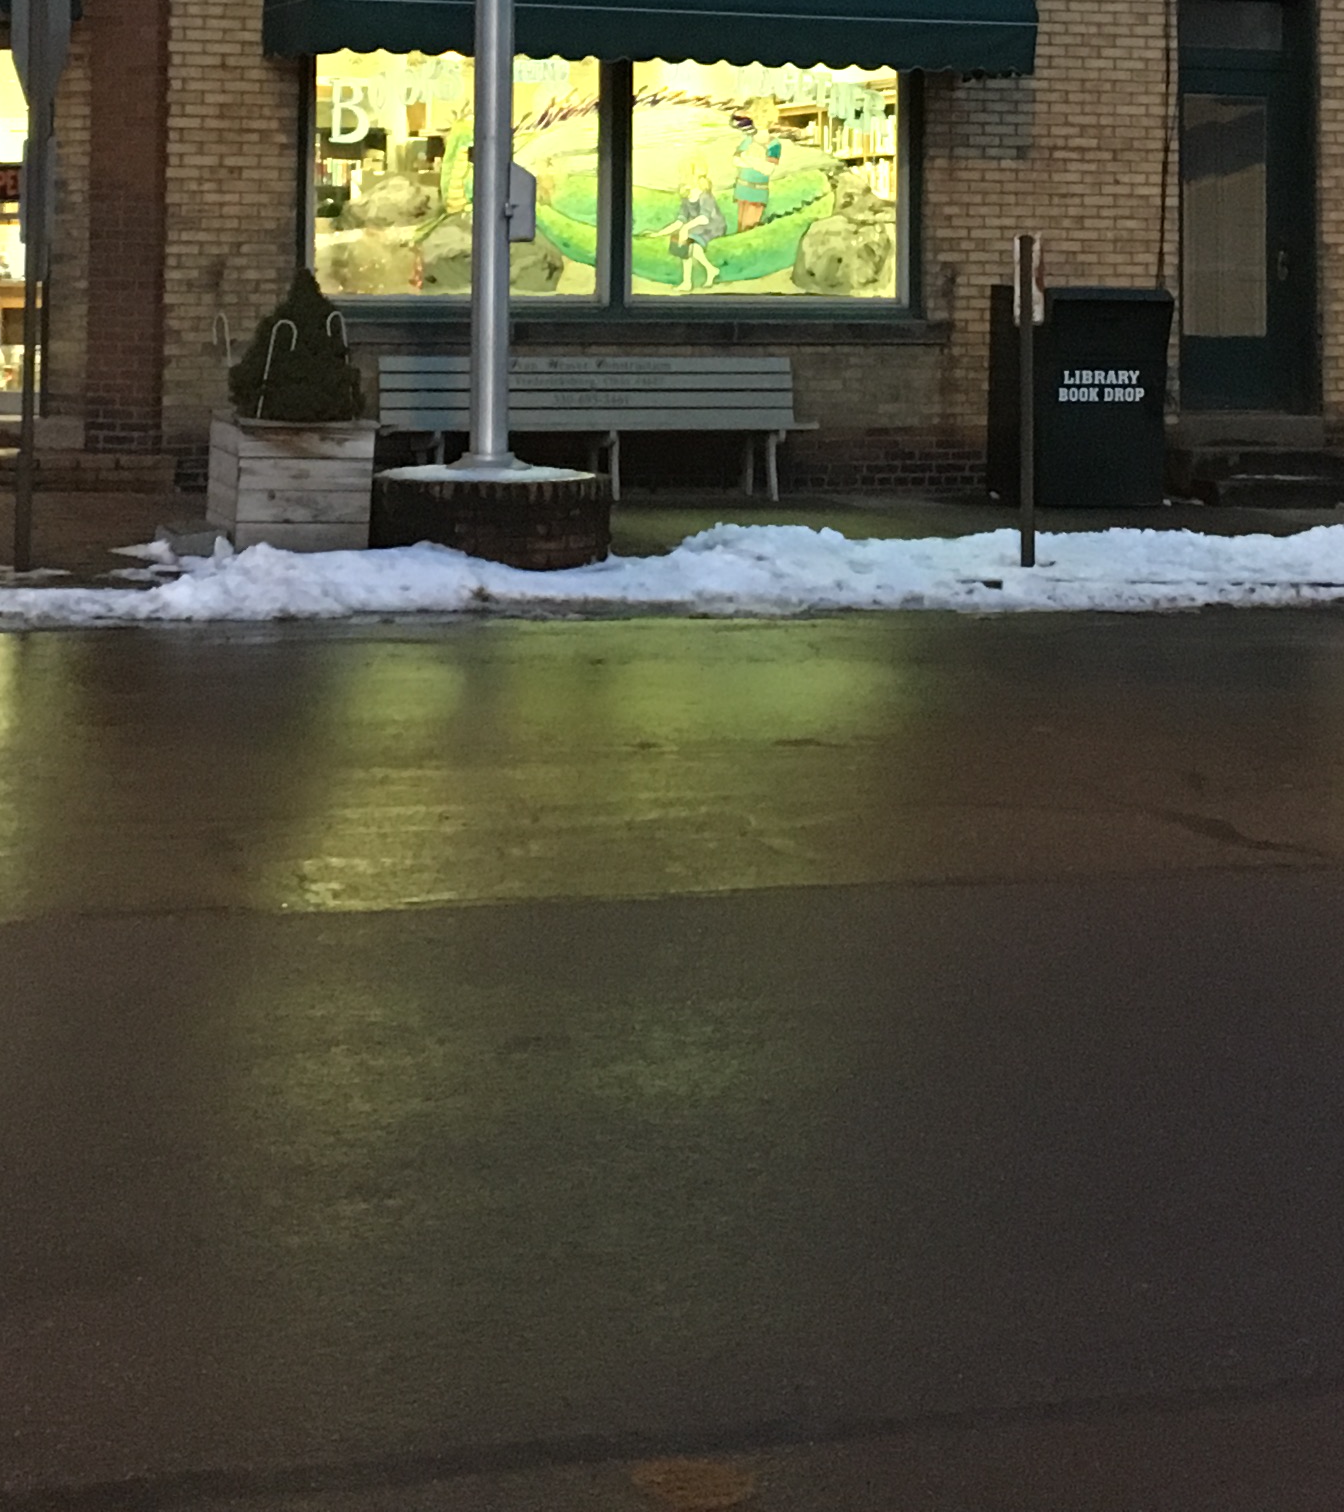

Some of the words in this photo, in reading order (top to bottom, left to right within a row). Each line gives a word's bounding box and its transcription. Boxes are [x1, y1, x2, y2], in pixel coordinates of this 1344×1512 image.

[1063, 370, 1140, 385] LIBRARY
[1058, 387, 1099, 402] BOOK
[1103, 387, 1145, 402] DROP
